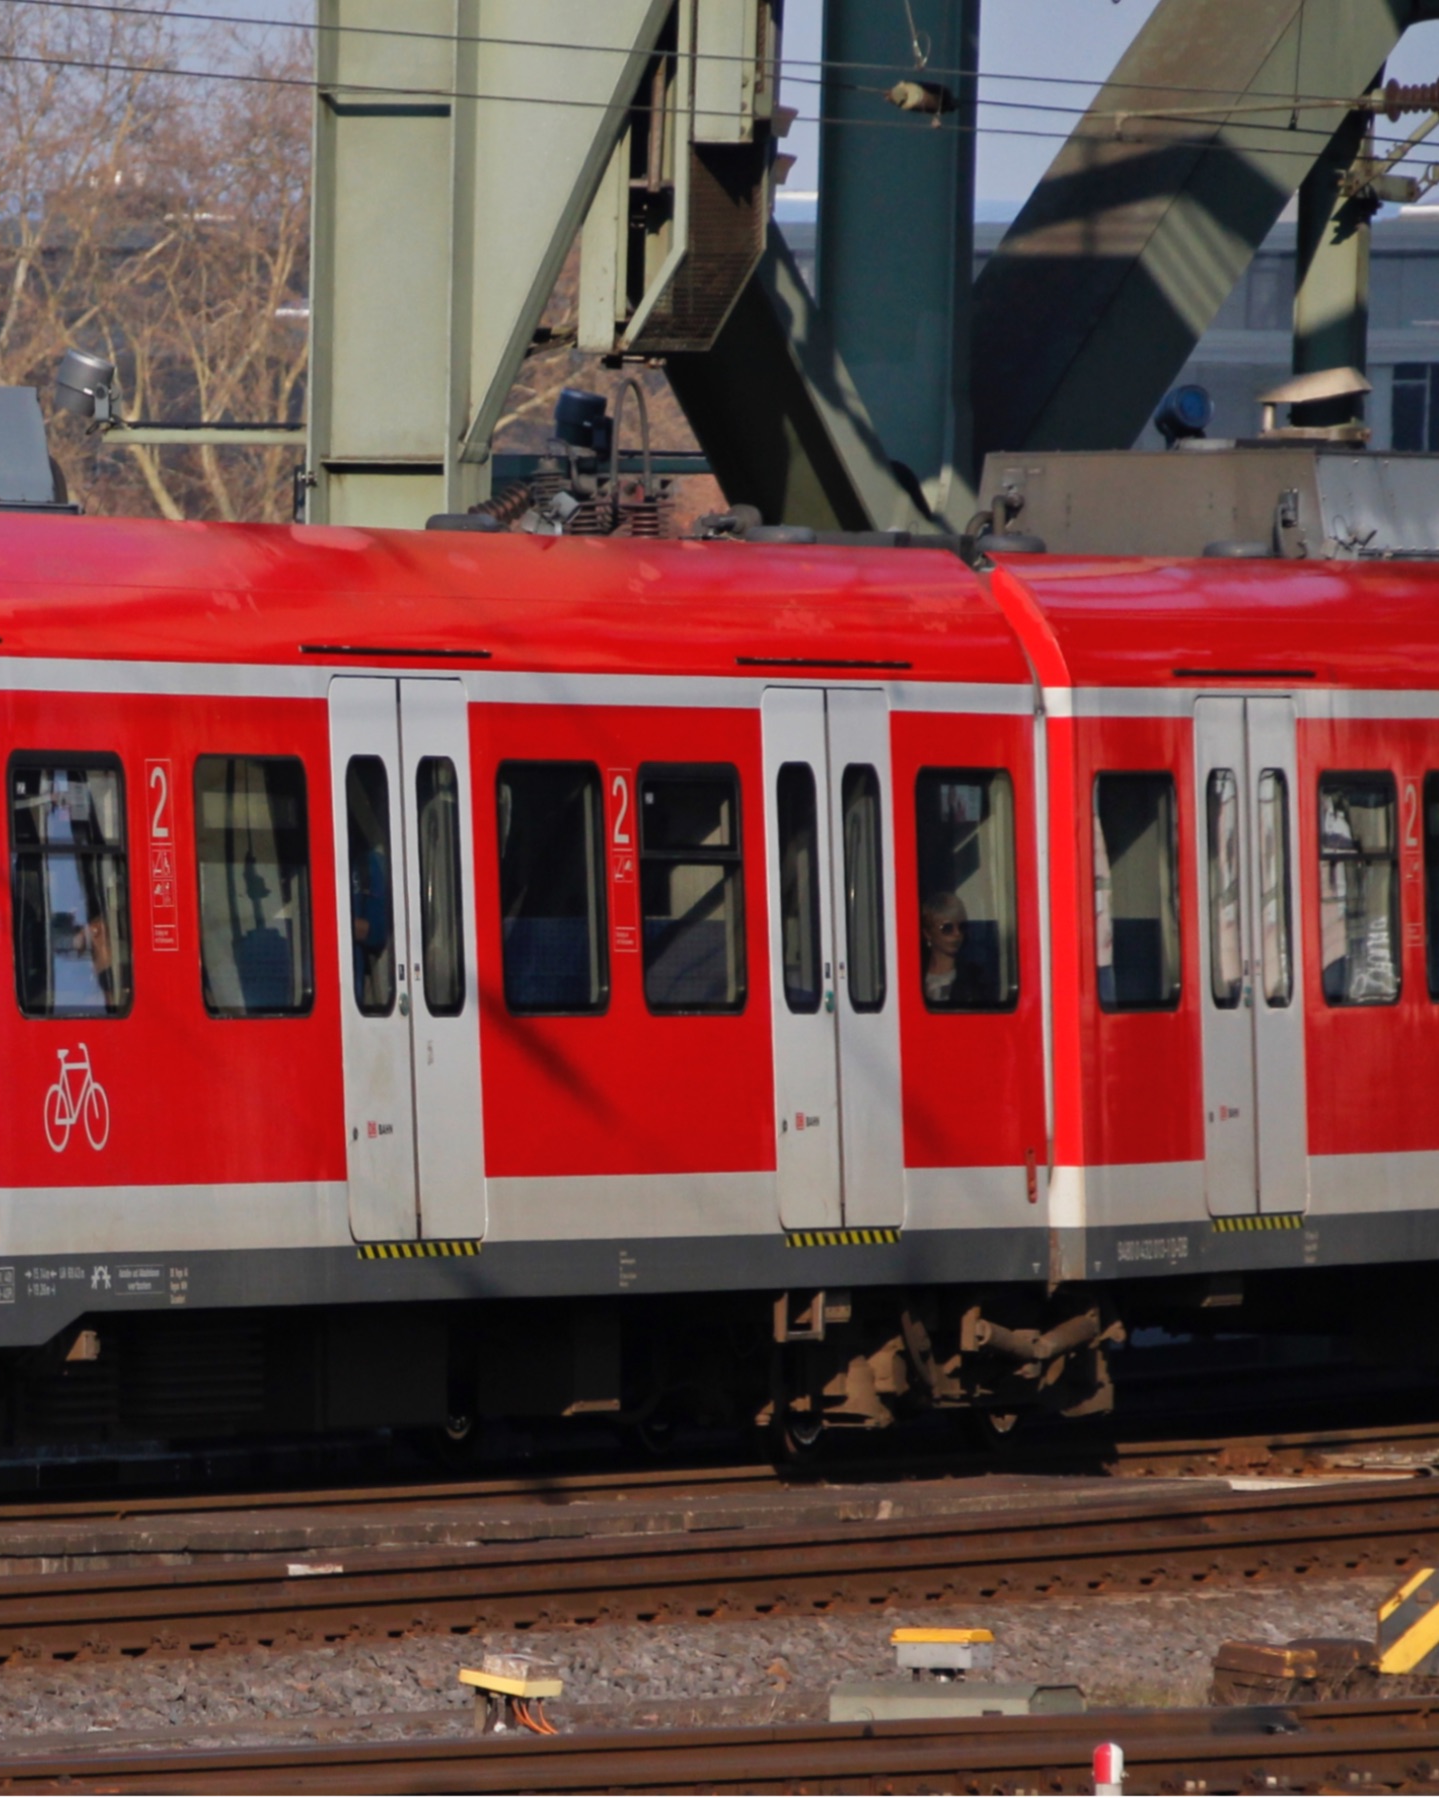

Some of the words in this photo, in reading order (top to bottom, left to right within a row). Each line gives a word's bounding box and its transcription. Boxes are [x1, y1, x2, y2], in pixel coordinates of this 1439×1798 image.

[150, 766, 169, 838] 2
[613, 775, 630, 844] 2
[1405, 783, 1418, 847] 2
[378, 1123, 393, 1136] BAHN
